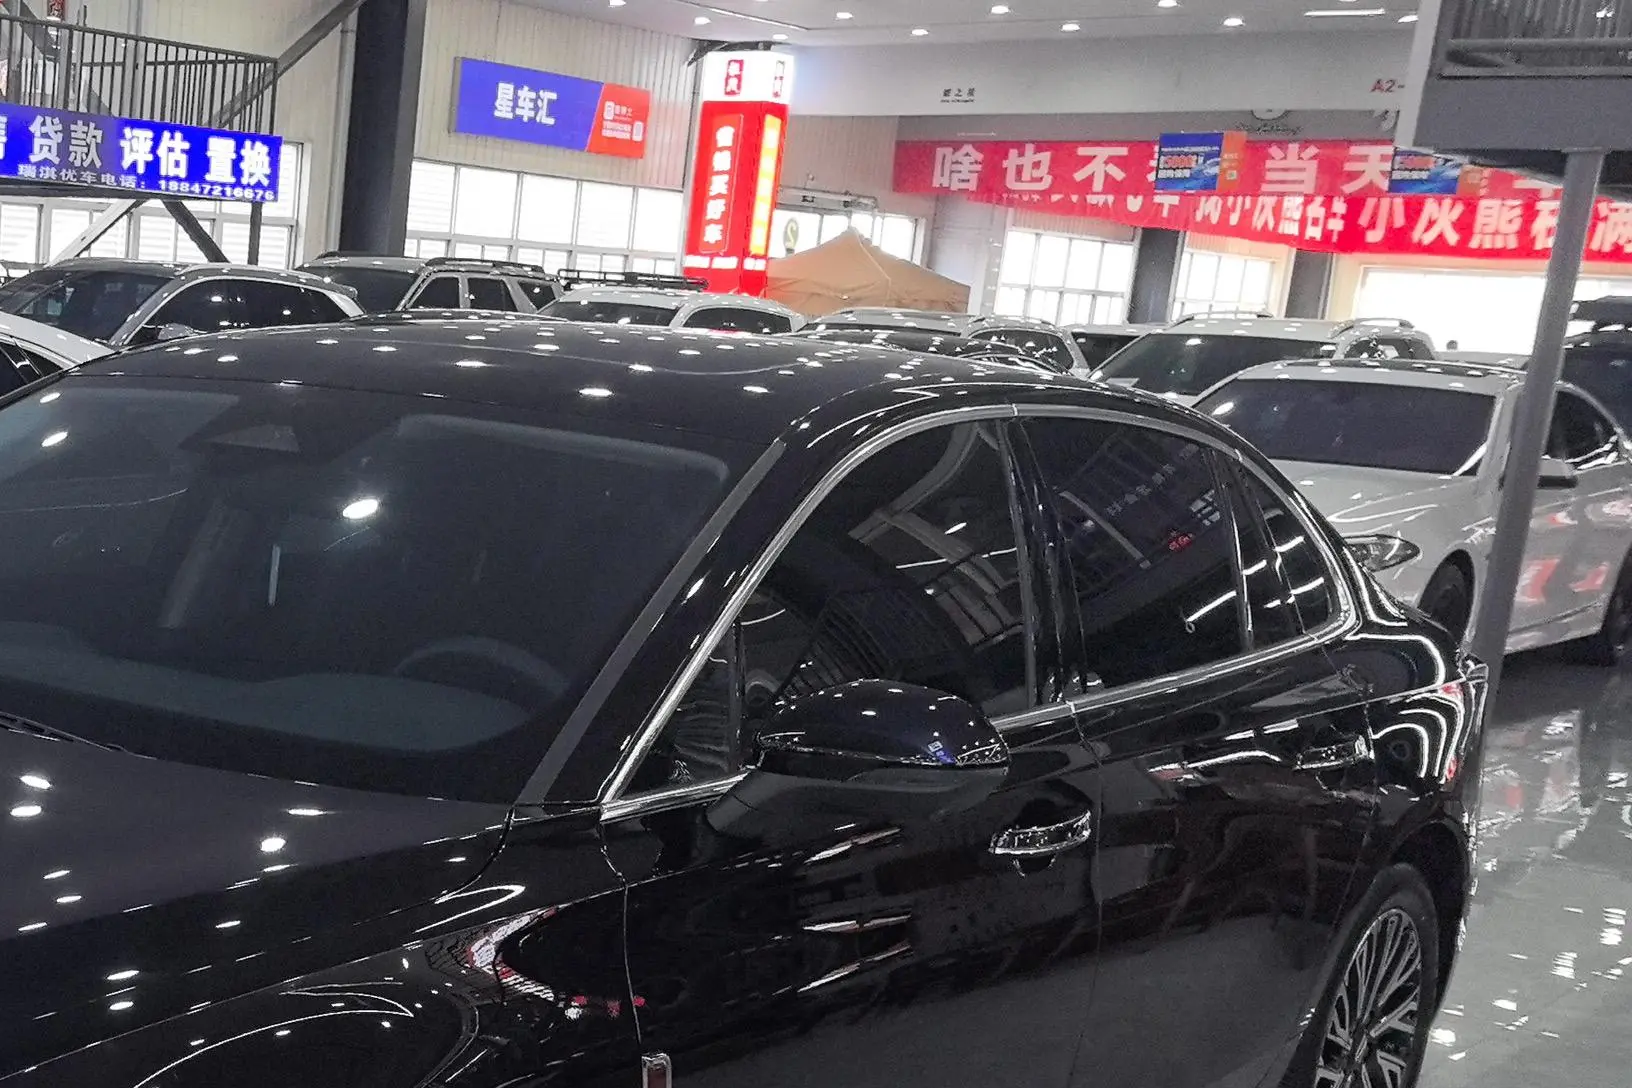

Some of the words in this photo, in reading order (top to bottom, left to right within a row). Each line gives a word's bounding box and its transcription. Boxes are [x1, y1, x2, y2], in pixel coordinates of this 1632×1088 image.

[493, 81, 558, 126] 星车汇
[28, 115, 104, 169] 贷款
[120, 126, 190, 179] 评估
[205, 137, 273, 187] 置换
[932, 144, 1159, 193] 啥也不
